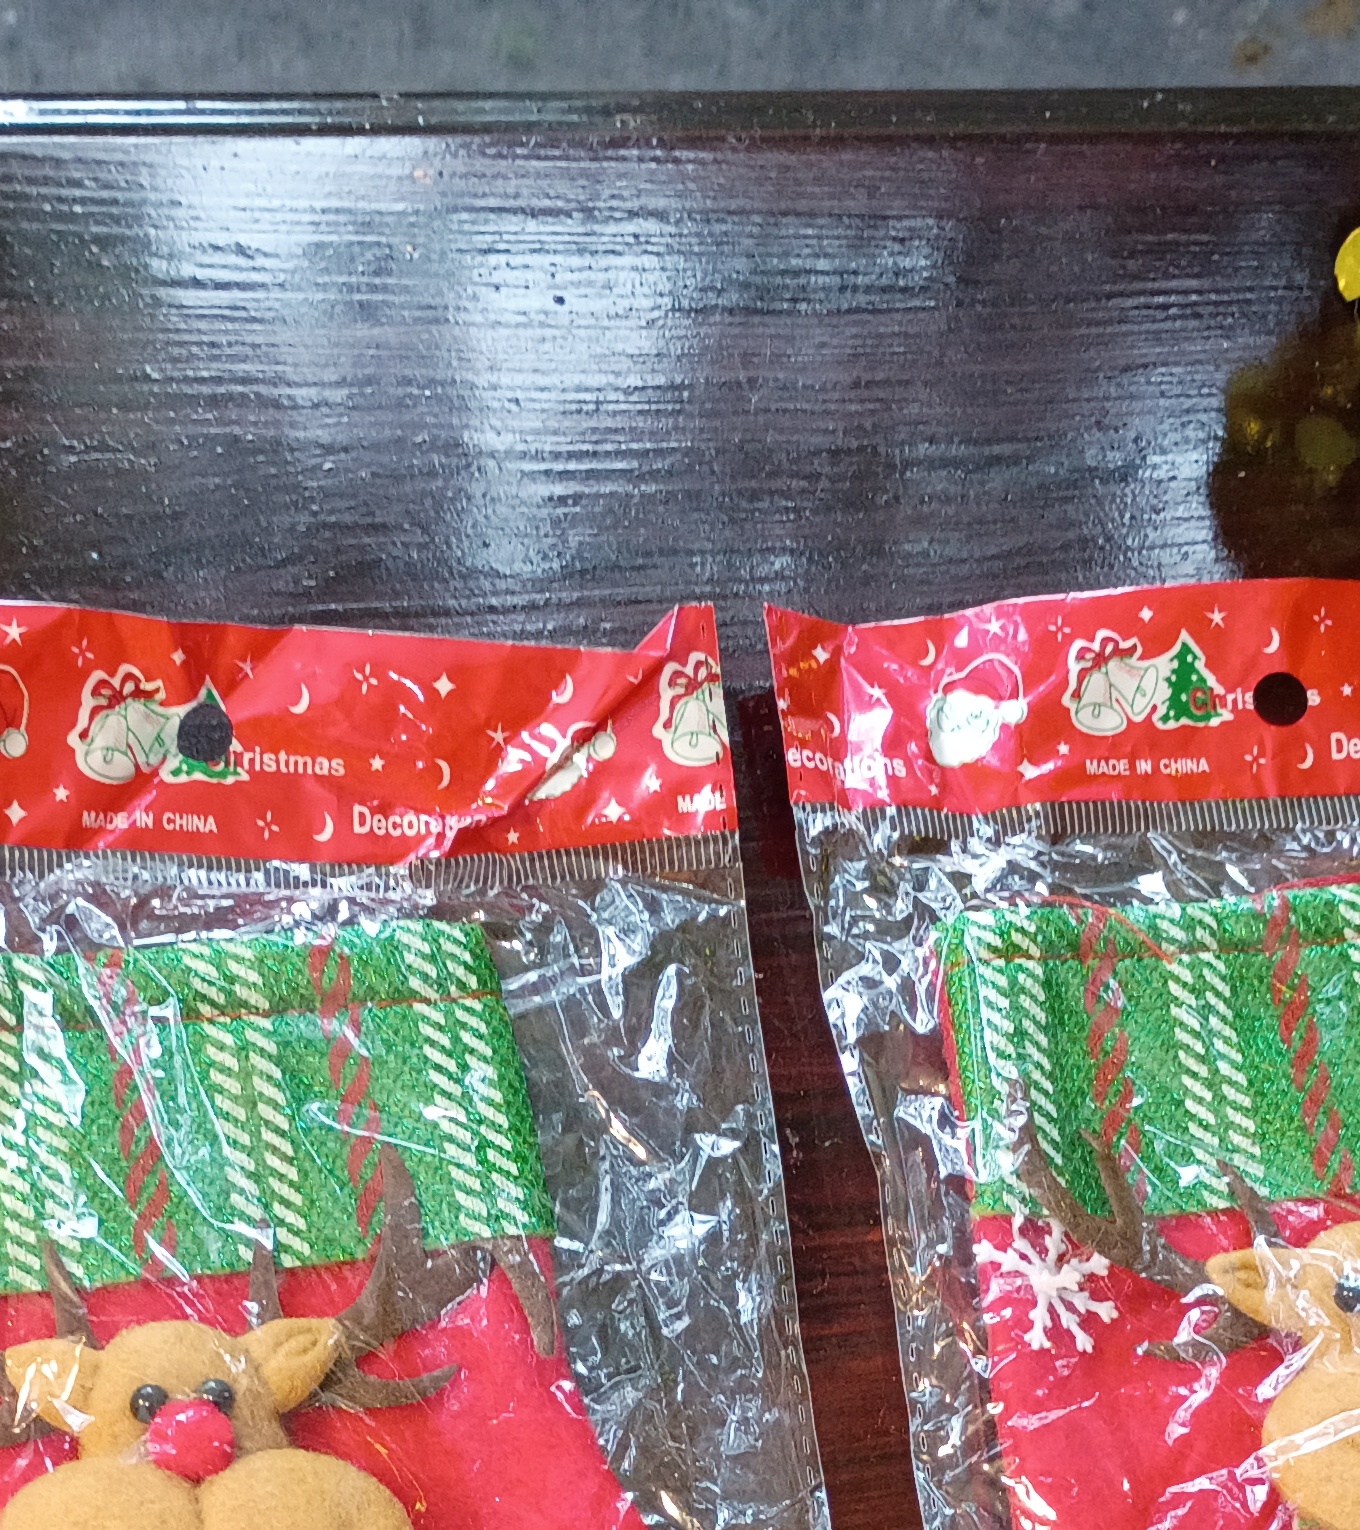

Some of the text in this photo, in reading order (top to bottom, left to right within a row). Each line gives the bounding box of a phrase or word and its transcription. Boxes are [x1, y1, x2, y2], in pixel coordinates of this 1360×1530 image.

[1190, 686, 1322, 715] Chriss
[1085, 757, 1211, 776] MADE IN CHINA
[82, 810, 218, 834] MADE IN CHINA
